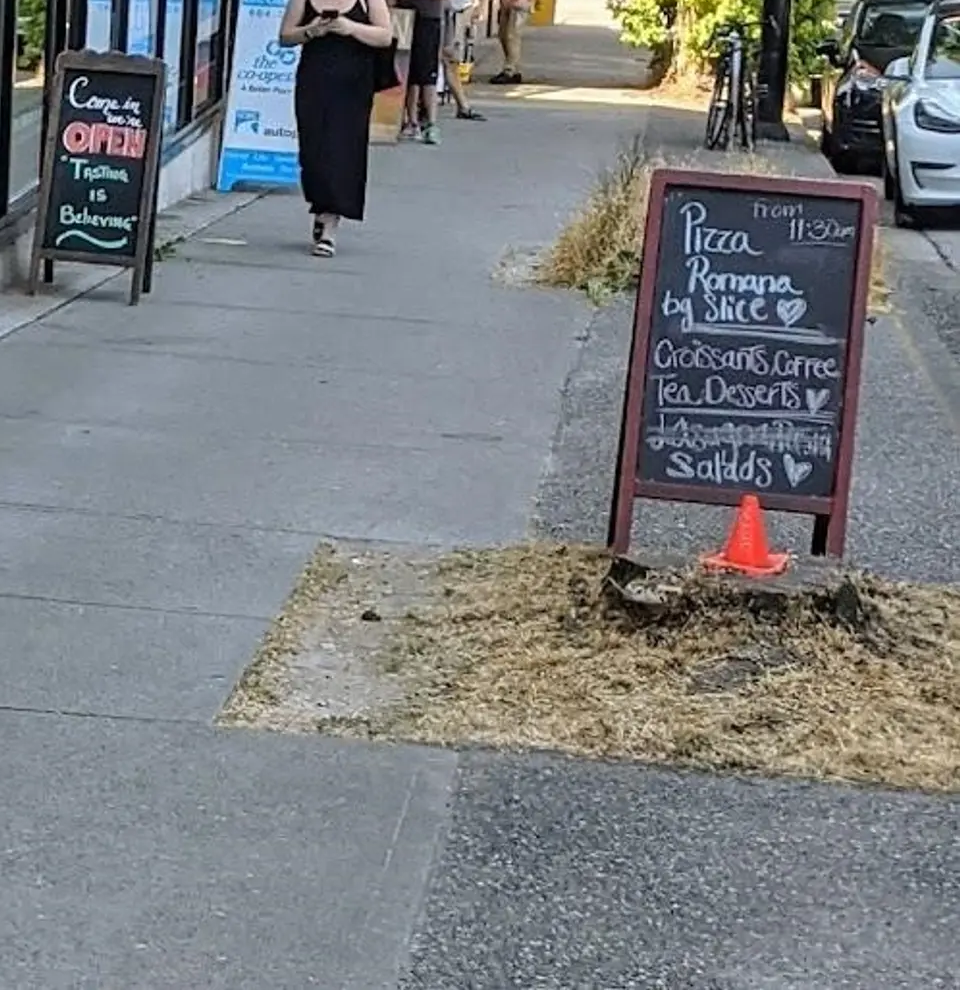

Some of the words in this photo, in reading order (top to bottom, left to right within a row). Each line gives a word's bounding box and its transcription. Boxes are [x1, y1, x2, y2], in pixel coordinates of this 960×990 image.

[69, 75, 120, 116] Come
[122, 97, 141, 115] in
[62, 121, 148, 159] OPEN
[680, 201, 763, 256] Pizza
[686, 256, 803, 295] Romana
[662, 291, 692, 333] by
[704, 293, 769, 323] Slice
[705, 376, 802, 409] Desserts
[666, 450, 773, 488] Salads
